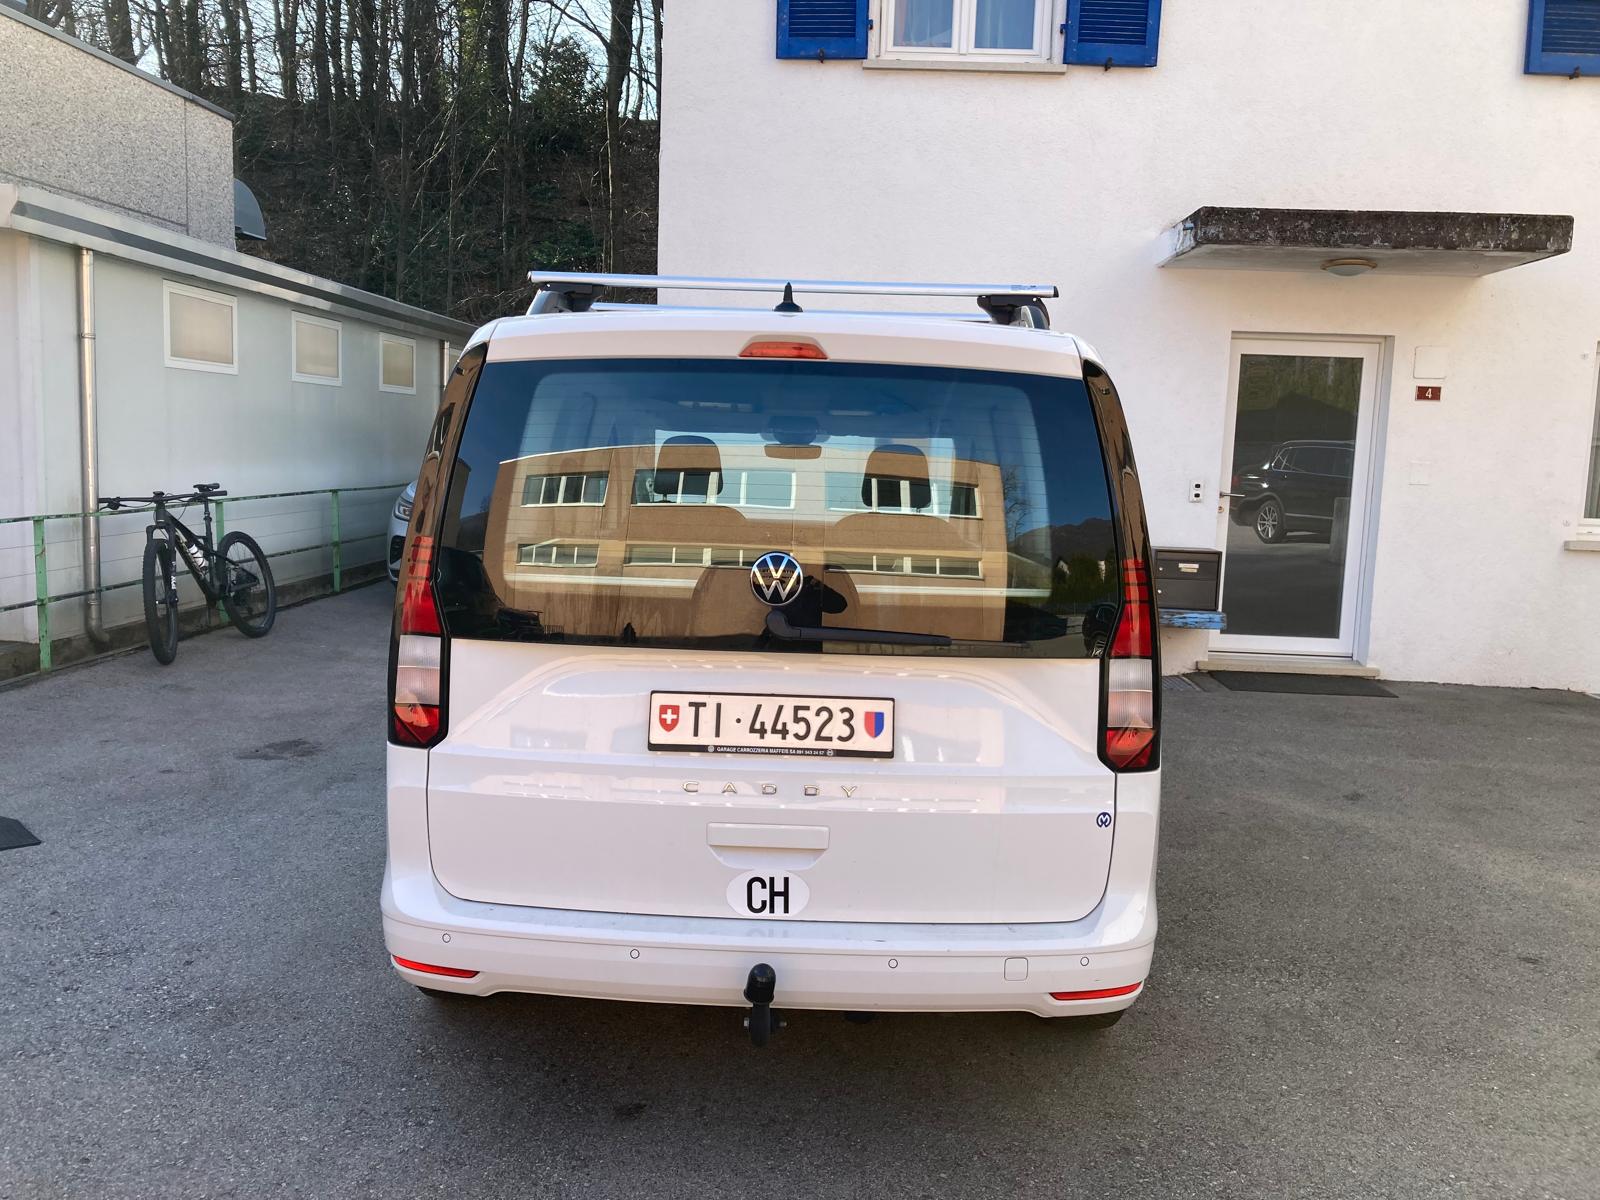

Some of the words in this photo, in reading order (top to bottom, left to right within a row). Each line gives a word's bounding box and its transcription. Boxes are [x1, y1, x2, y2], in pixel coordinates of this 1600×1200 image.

[1425, 387, 1432, 399] 4
[682, 781, 857, 798] CADDY
[746, 876, 790, 914] CH
